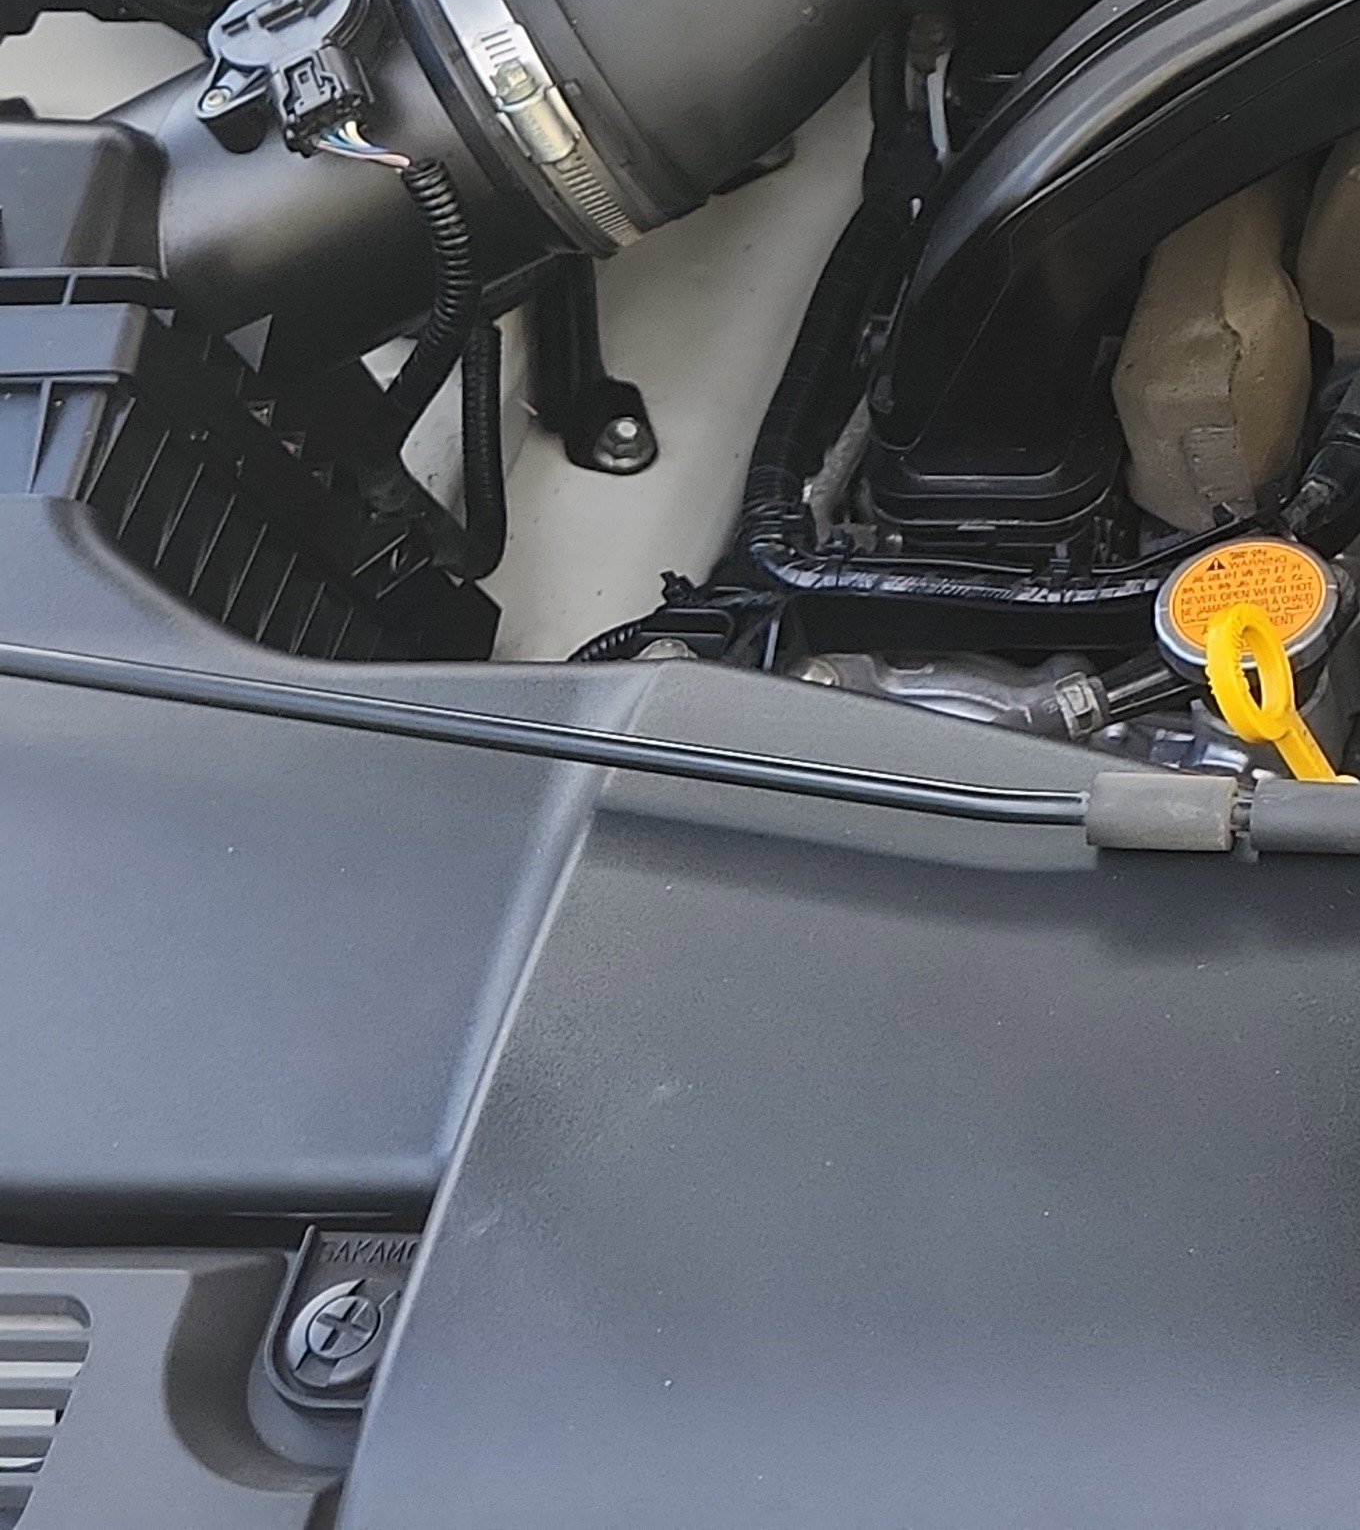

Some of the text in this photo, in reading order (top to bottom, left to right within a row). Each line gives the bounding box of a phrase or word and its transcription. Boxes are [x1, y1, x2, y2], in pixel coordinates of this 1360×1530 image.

[1228, 555, 1288, 570] WARNING
[1181, 593, 1217, 606] NEVER
[1220, 588, 1250, 602] OPEN
[1253, 585, 1287, 597] WHEN
